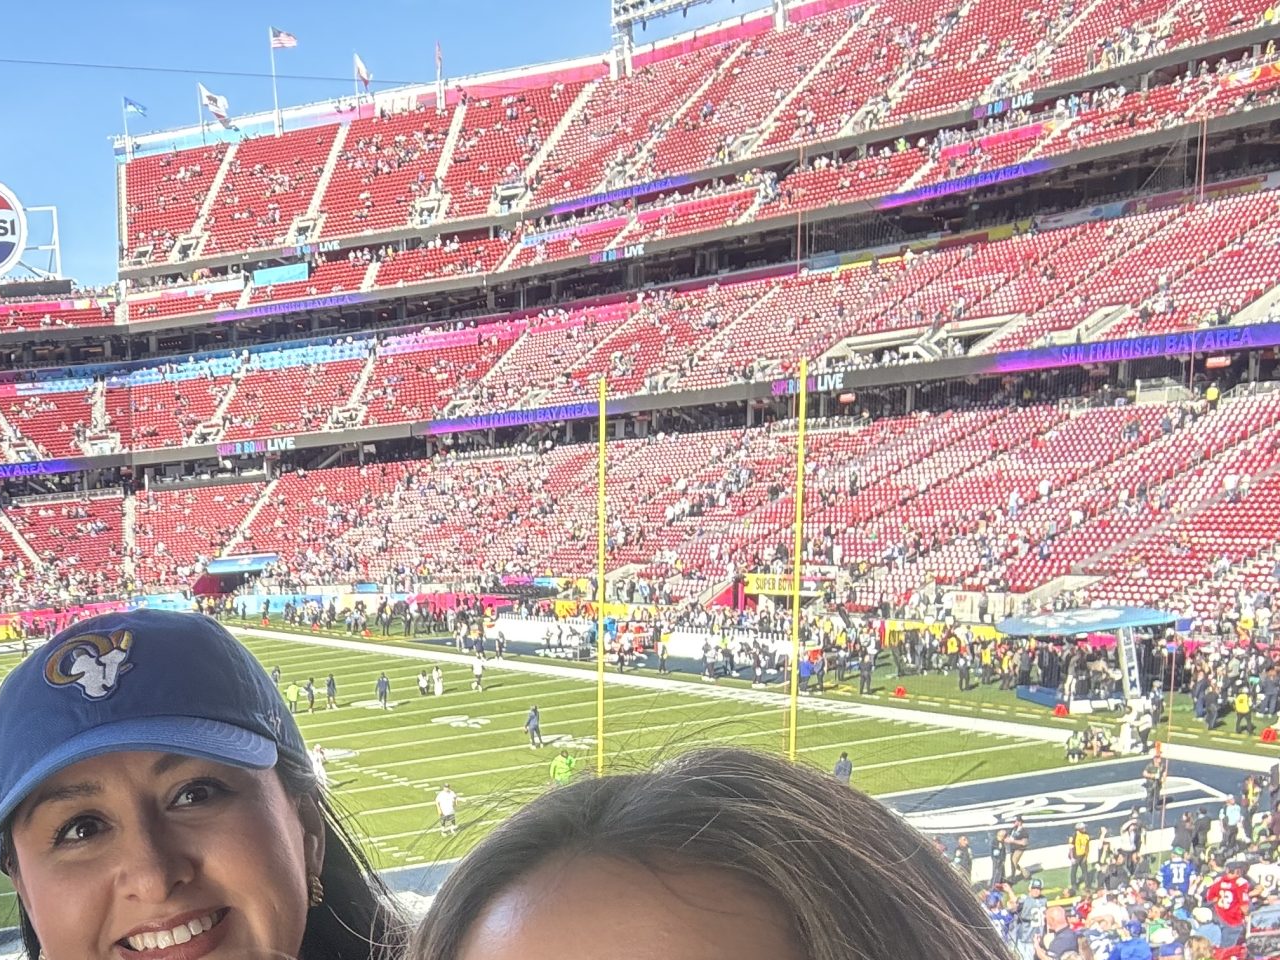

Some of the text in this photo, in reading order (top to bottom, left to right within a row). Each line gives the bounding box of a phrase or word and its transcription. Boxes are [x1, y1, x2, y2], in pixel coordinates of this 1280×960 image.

[1061, 327, 1253, 364] SAN FRANCISCO BAY AREA
[818, 373, 844, 392] LIVE
[536, 408, 559, 421] BAY
[559, 404, 590, 419] AREA
[267, 437, 296, 451] LIVE
[14, 462, 46, 475] AREA
